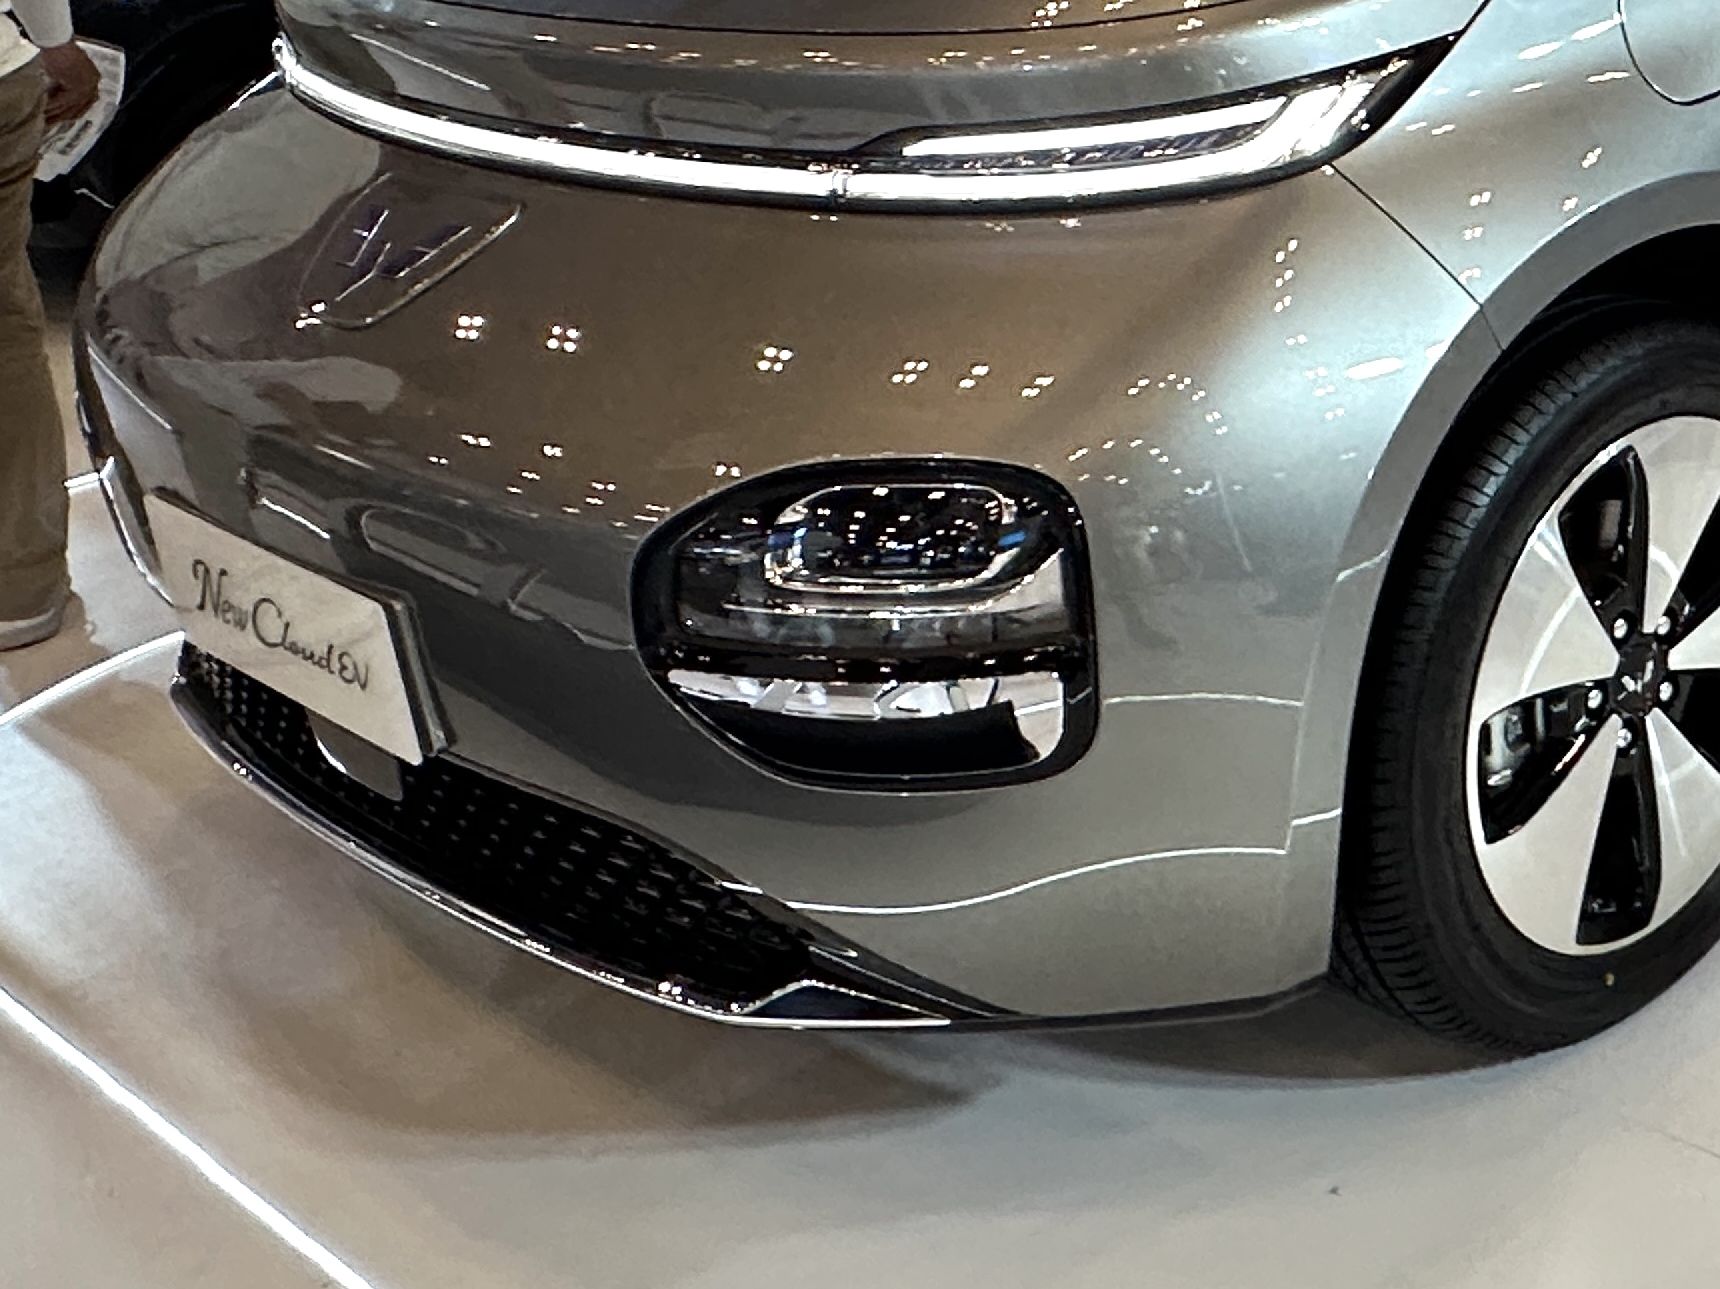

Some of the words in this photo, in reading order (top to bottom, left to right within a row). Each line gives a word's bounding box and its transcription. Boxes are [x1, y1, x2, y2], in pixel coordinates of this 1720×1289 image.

[192, 558, 248, 631] New
[252, 597, 335, 675] Cloud
[338, 651, 369, 691] EV
